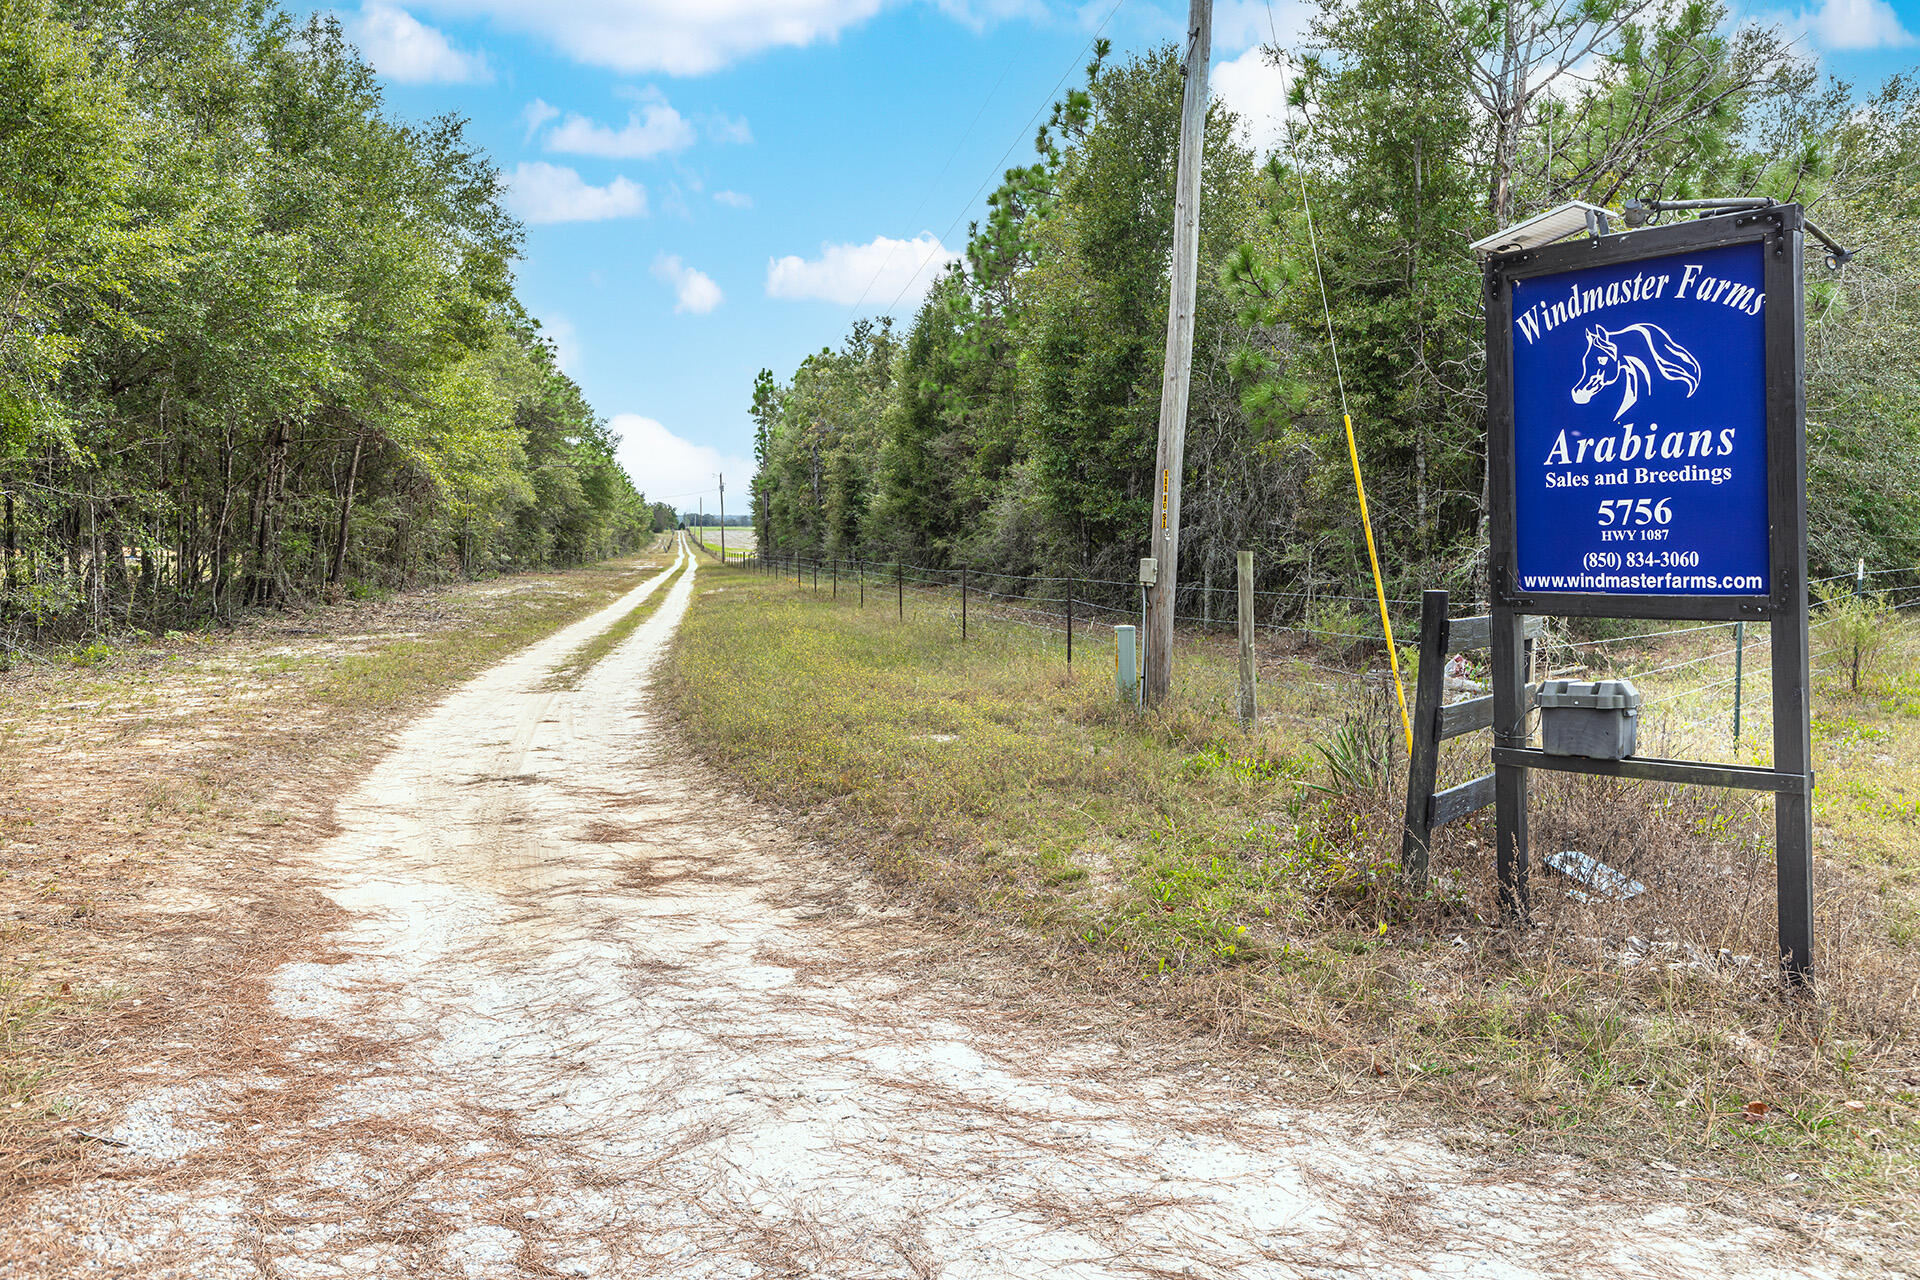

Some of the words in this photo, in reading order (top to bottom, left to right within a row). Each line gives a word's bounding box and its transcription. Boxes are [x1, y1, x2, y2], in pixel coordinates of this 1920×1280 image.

[1515, 271, 1671, 346] Windmaster
[1673, 264, 1767, 317] Farms
[1543, 422, 1737, 466] Arabians
[1545, 471, 1590, 489] Sales
[1594, 470, 1630, 486] and
[1634, 466, 1733, 486] Breedings
[1597, 496, 1674, 526] 5756
[1601, 529, 1637, 543] HWY
[1640, 528, 1670, 542] 1087
[1582, 551, 1622, 573] (850)
[1626, 550, 1700, 570] 834-3060
[1523, 575, 1764, 591] www.windmasterfarms.com
